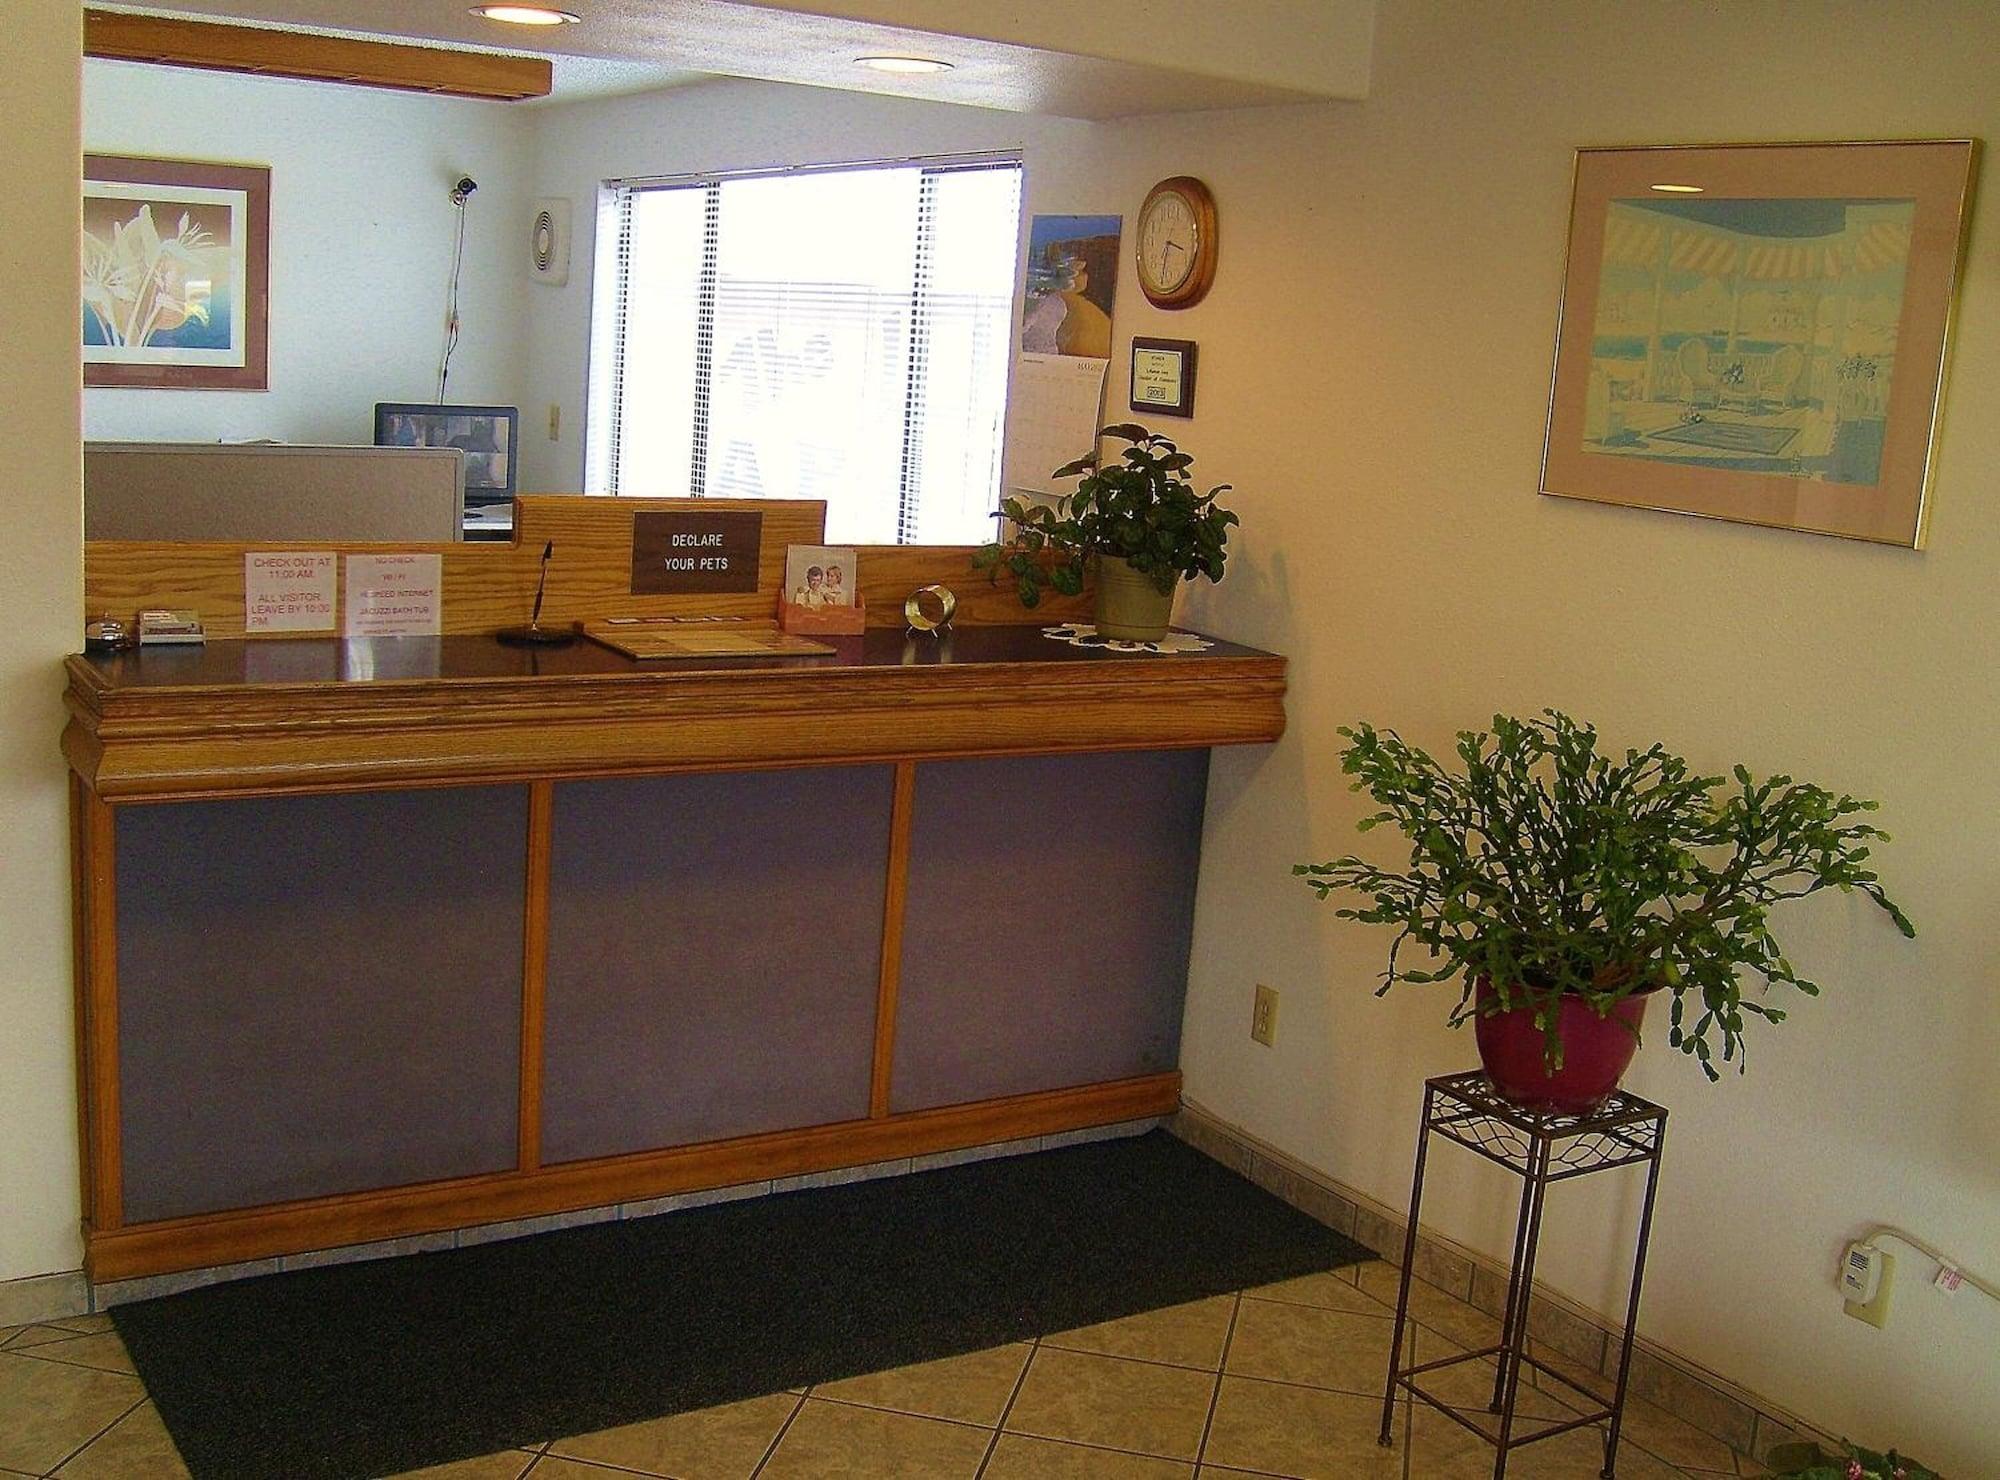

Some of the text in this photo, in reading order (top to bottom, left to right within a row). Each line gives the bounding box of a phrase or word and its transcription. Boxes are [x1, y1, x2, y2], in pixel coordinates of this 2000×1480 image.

[672, 534, 723, 547] DECLARE
[254, 558, 331, 567] CHECK OUT AT
[665, 557, 728, 570] YOUR PETS
[258, 592, 320, 603] ALL VISITOR
[252, 605, 284, 614] LEAVE
[287, 604, 300, 613] BY
